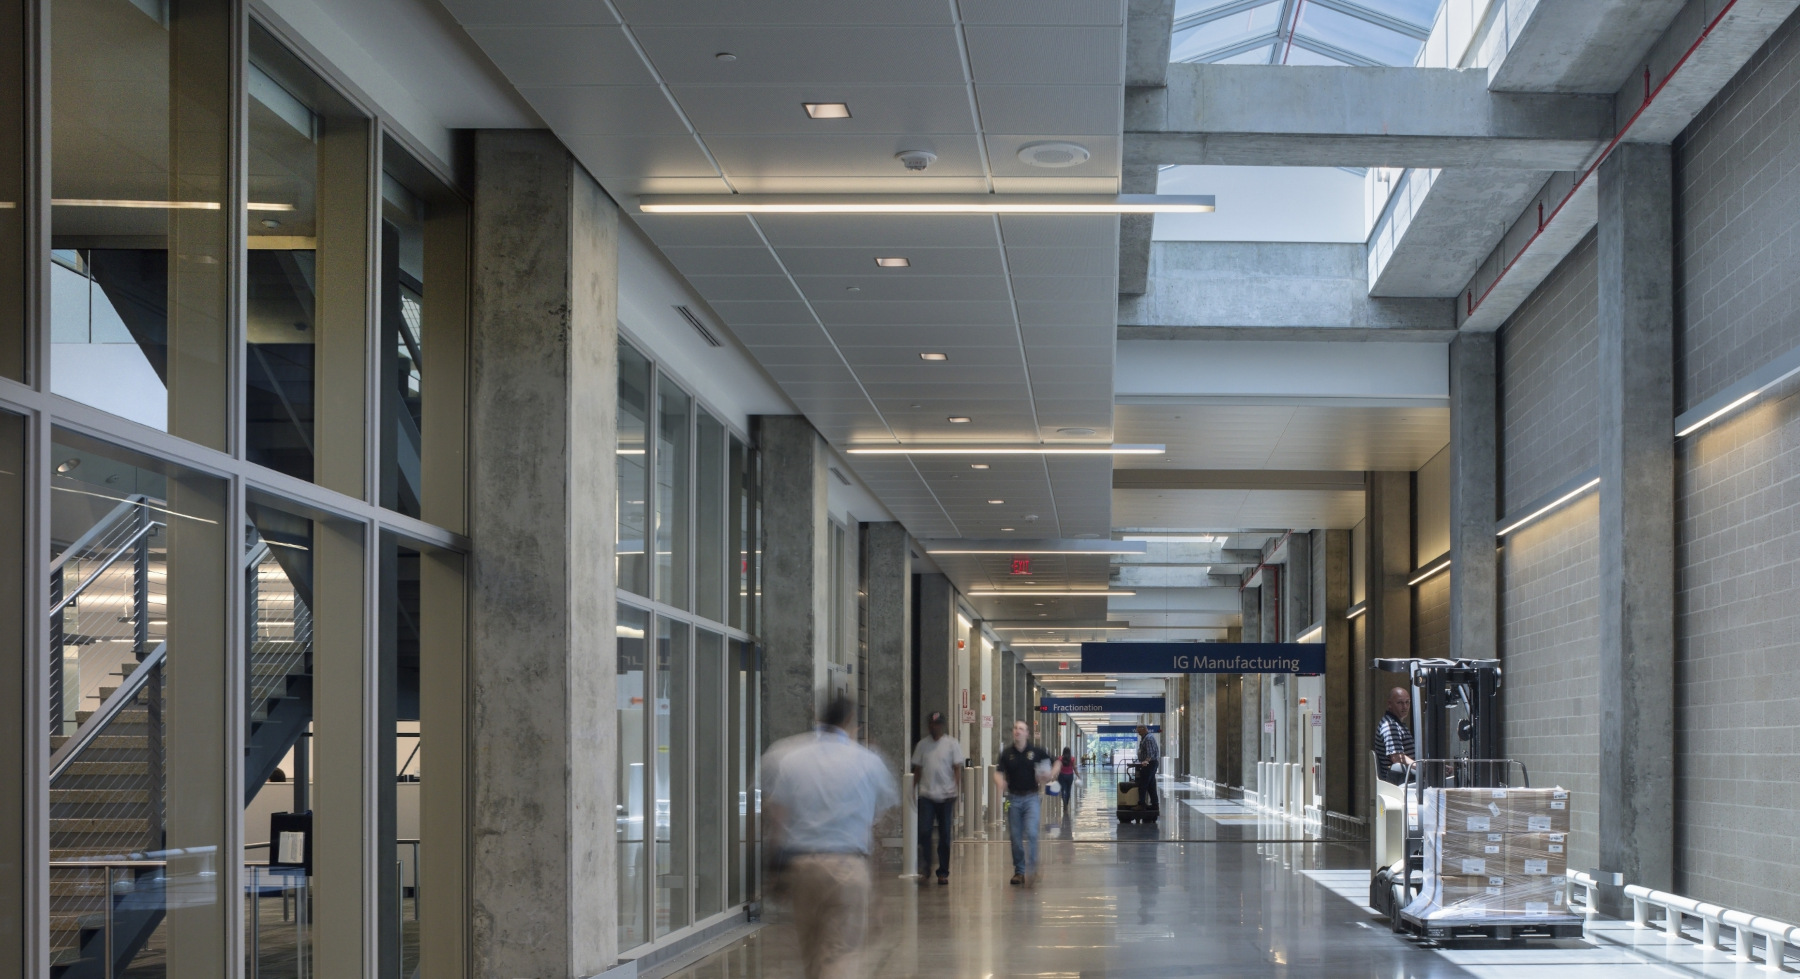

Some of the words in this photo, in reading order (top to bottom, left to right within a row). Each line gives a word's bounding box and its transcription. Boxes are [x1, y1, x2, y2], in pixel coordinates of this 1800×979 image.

[1013, 560, 1030, 574] EXIT
[1173, 655, 1189, 669] IG
[1193, 655, 1300, 672] Manufacturing
[1053, 703, 1103, 711] Fractionation
